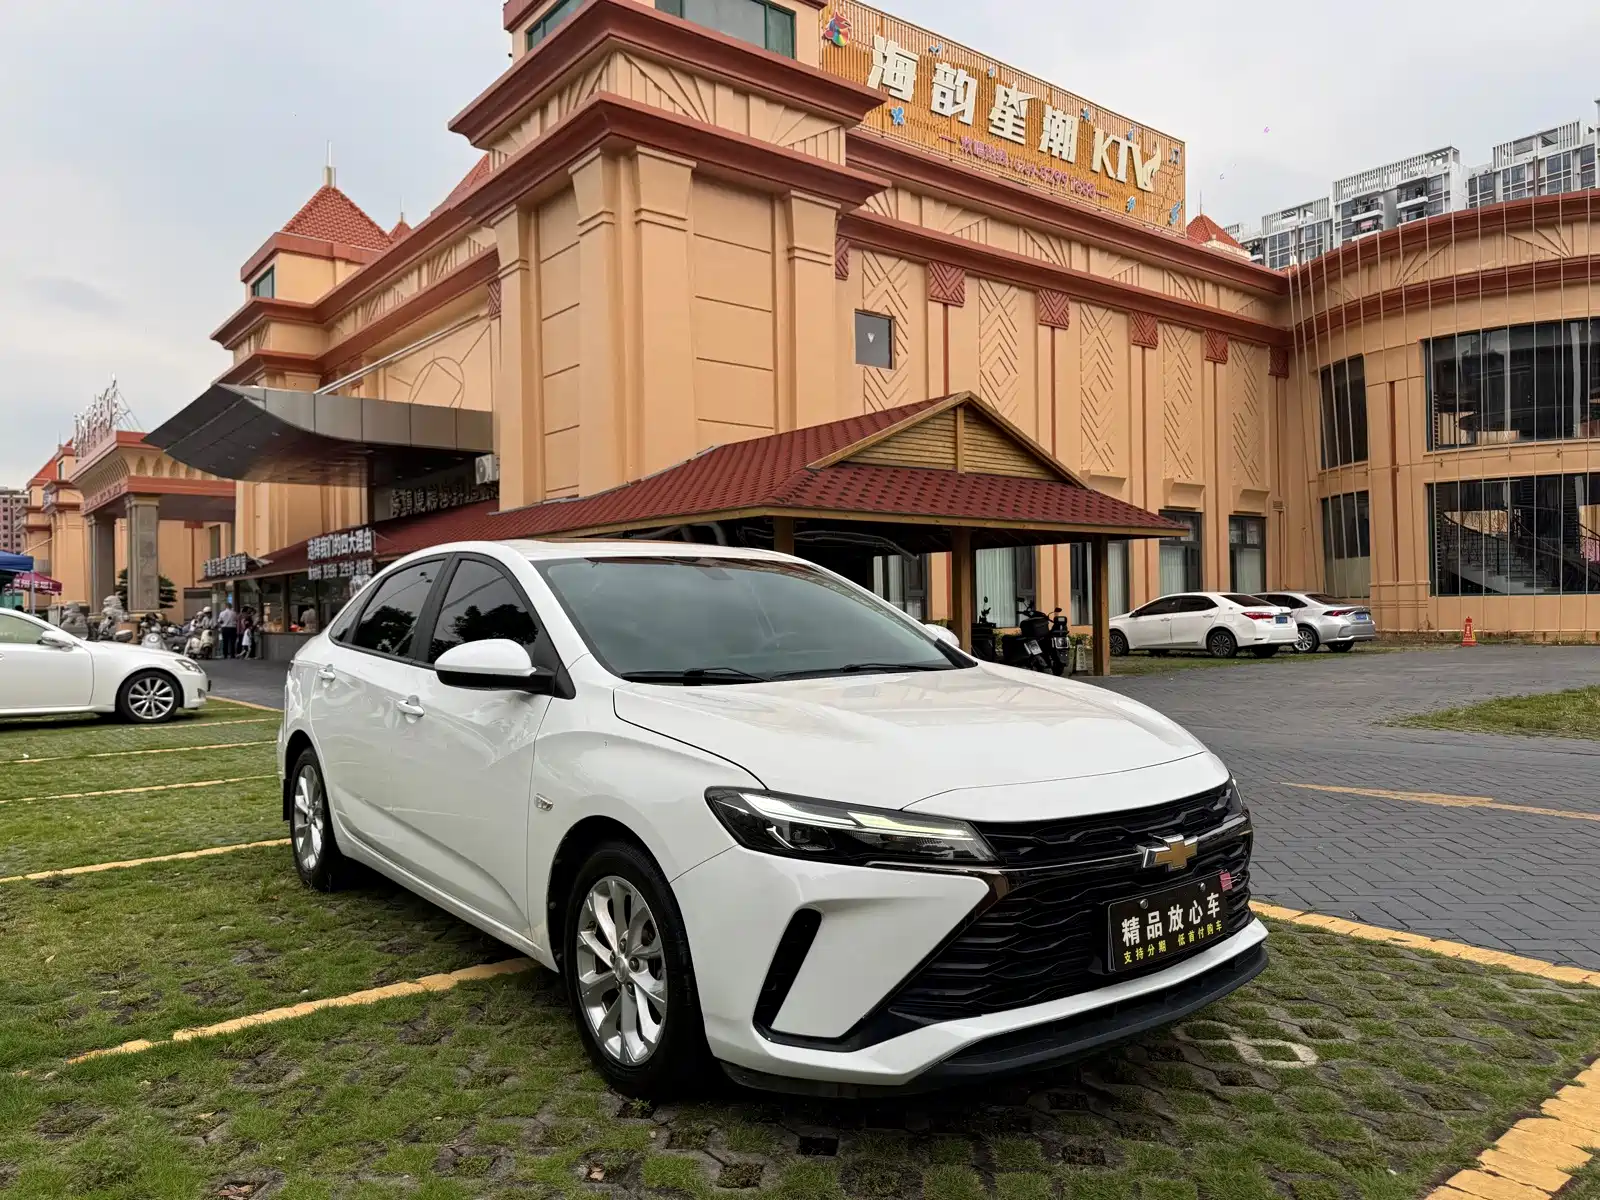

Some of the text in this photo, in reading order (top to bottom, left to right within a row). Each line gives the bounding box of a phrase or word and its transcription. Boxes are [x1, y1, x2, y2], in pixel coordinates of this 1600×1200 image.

[1121, 892, 1220, 947] 精品放心车
[1123, 920, 1223, 964] 支持分期 低首付购车
